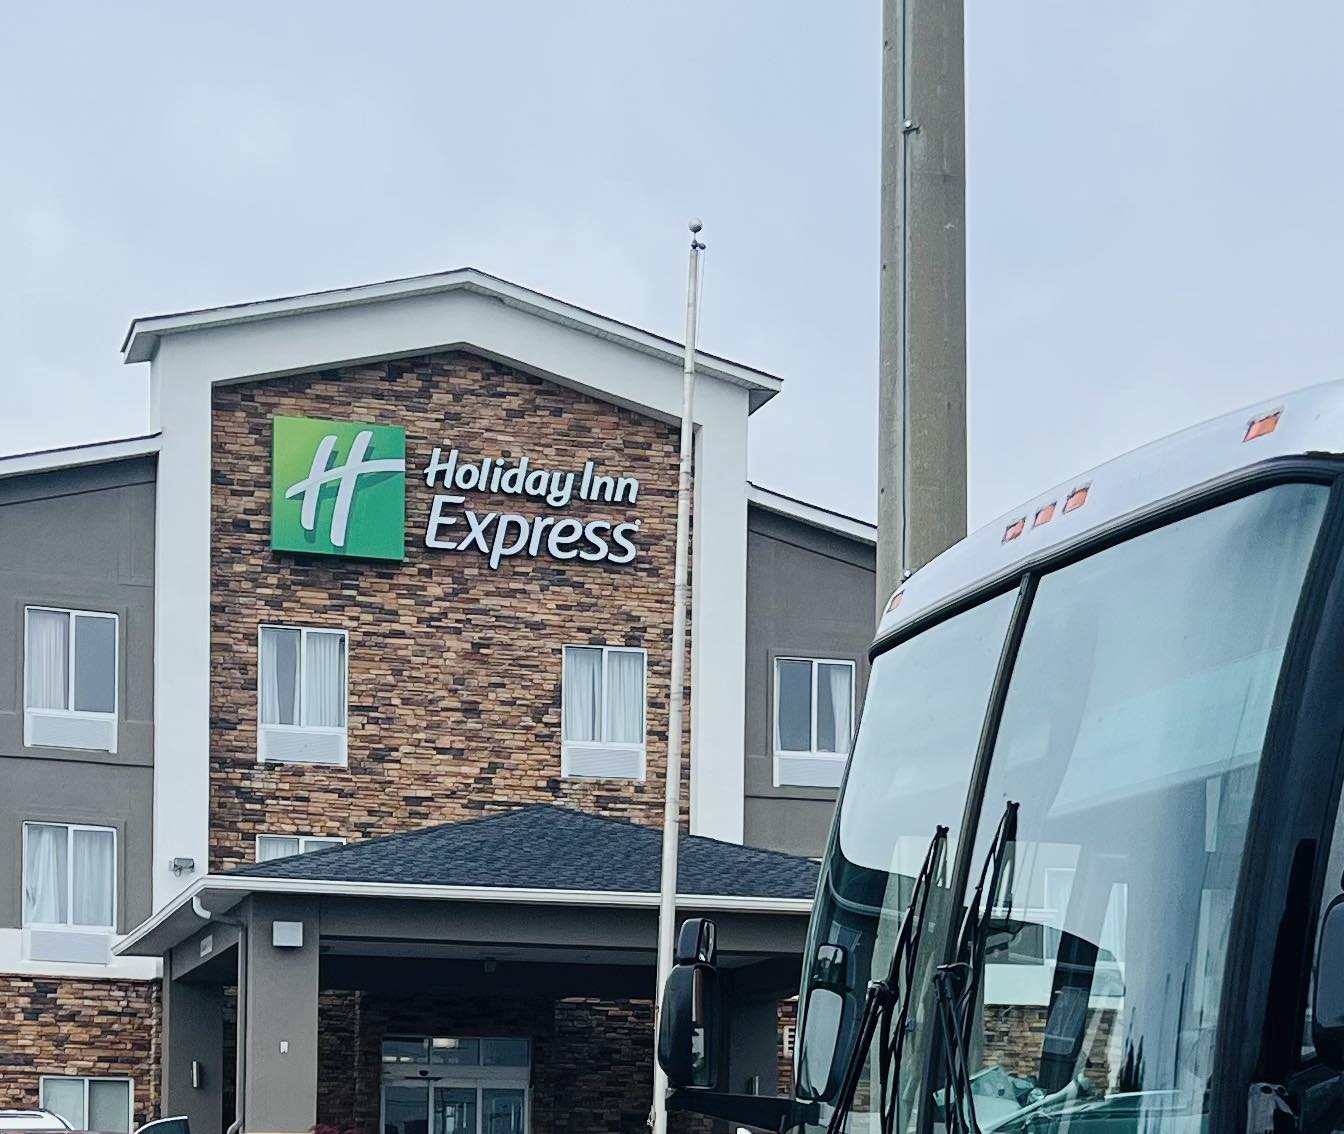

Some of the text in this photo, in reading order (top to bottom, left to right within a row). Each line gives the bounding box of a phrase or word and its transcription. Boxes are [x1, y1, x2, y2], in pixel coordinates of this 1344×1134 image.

[424, 447, 639, 507] Holiday Inn
[425, 494, 638, 570] Express
